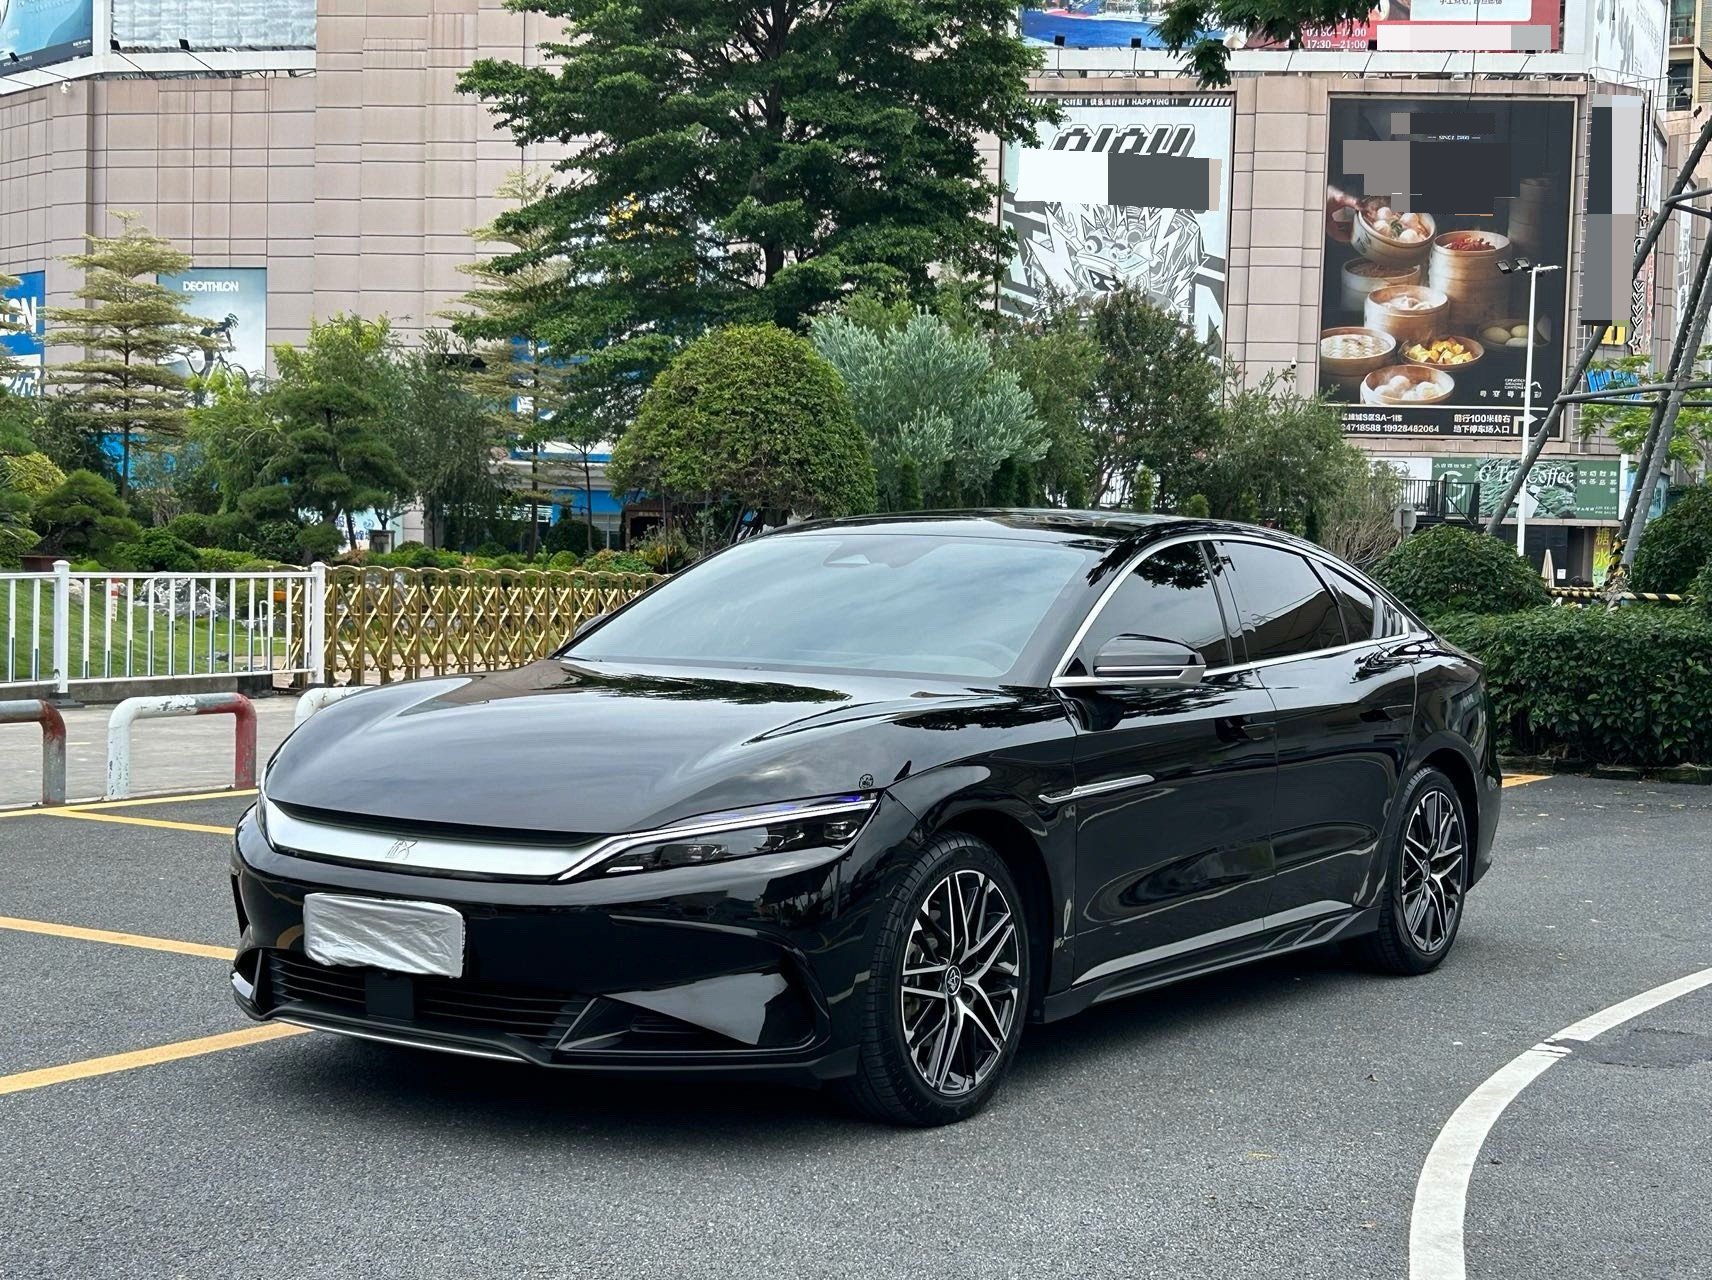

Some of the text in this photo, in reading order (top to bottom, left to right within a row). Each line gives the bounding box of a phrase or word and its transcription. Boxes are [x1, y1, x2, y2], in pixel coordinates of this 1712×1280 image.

[183, 281, 239, 293] DECATHLON
[1453, 425, 1510, 434] 地下停车场入口
[1526, 466, 1575, 488] Coffee
